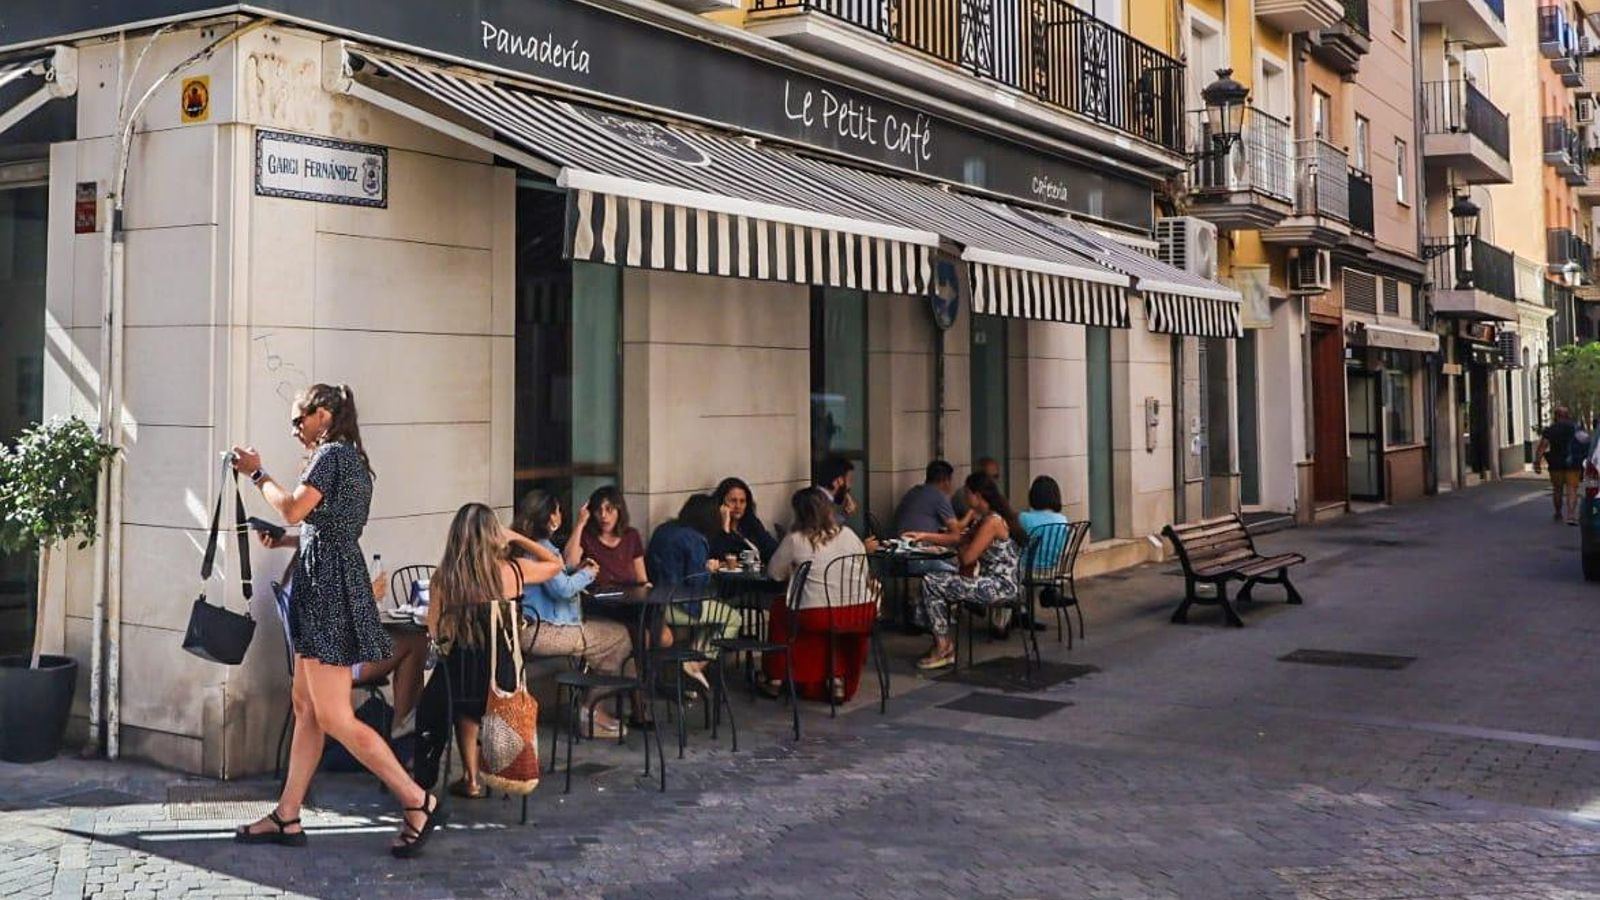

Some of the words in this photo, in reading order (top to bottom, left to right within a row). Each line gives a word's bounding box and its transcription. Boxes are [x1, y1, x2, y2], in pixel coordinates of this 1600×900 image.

[480, 20, 590, 74] Panadería
[784, 79, 814, 127] Le
[821, 89, 878, 145] Petit
[884, 113, 931, 171] Café
[304, 157, 358, 183] FERNÁNDEZ
